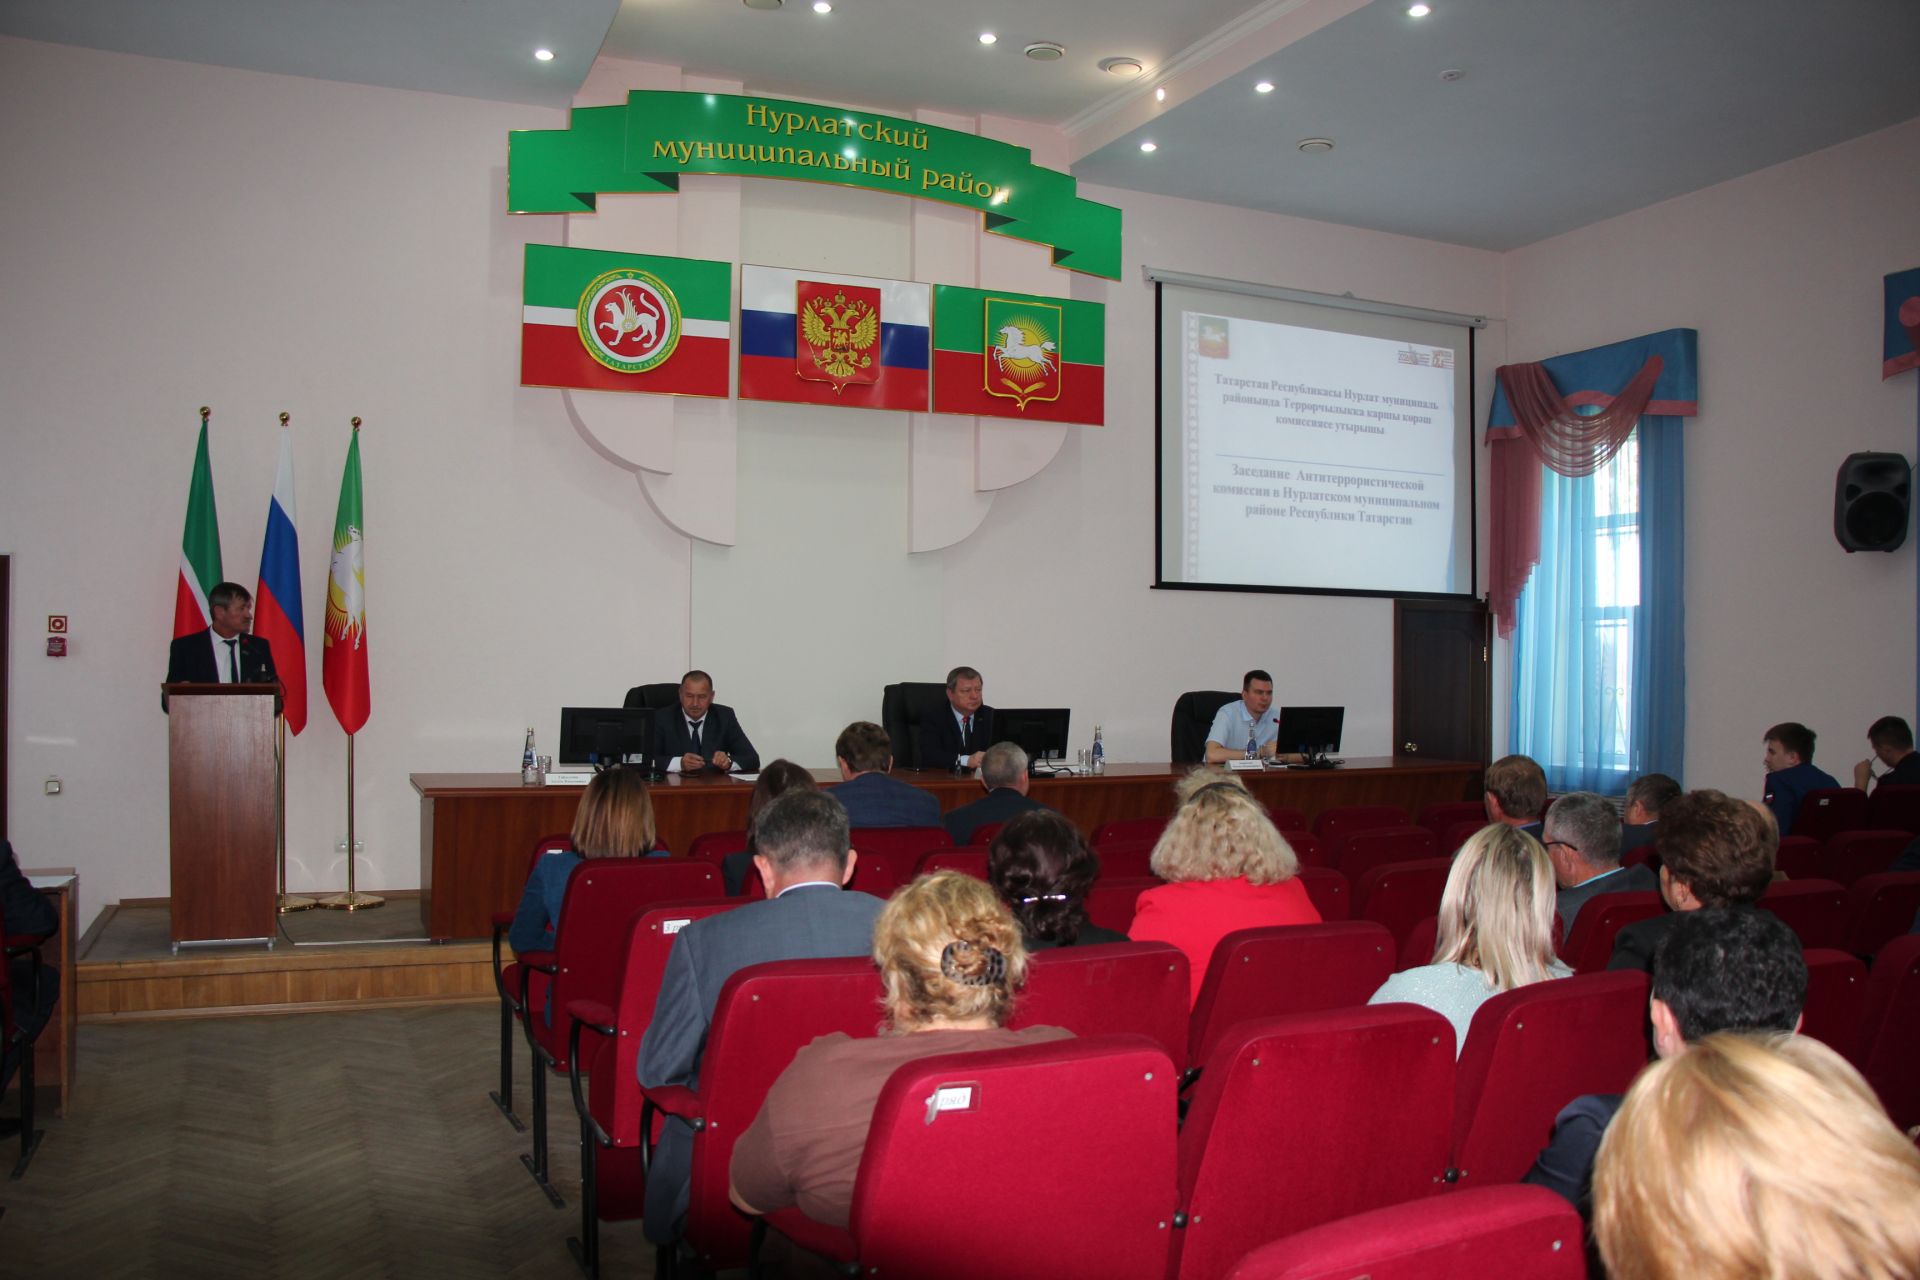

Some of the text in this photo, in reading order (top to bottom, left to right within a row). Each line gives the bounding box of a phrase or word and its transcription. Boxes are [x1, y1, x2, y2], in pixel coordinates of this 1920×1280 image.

[747, 103, 929, 151] Нурлатский
[653, 138, 1011, 205] муниципальный район
[1214, 373, 1439, 410] Татарстан Республикасы Нурлат муниципаль
[1222, 392, 1280, 408] районында
[1366, 409, 1401, 421] каршы
[1275, 415, 1385, 435] комиссиясе утырышы
[1231, 463, 1425, 491] Заседание Антитеррористической
[1212, 484, 1440, 511] комиссии в Нурлатском муниципальном
[1245, 503, 1413, 527] районе Республики Татарстан
